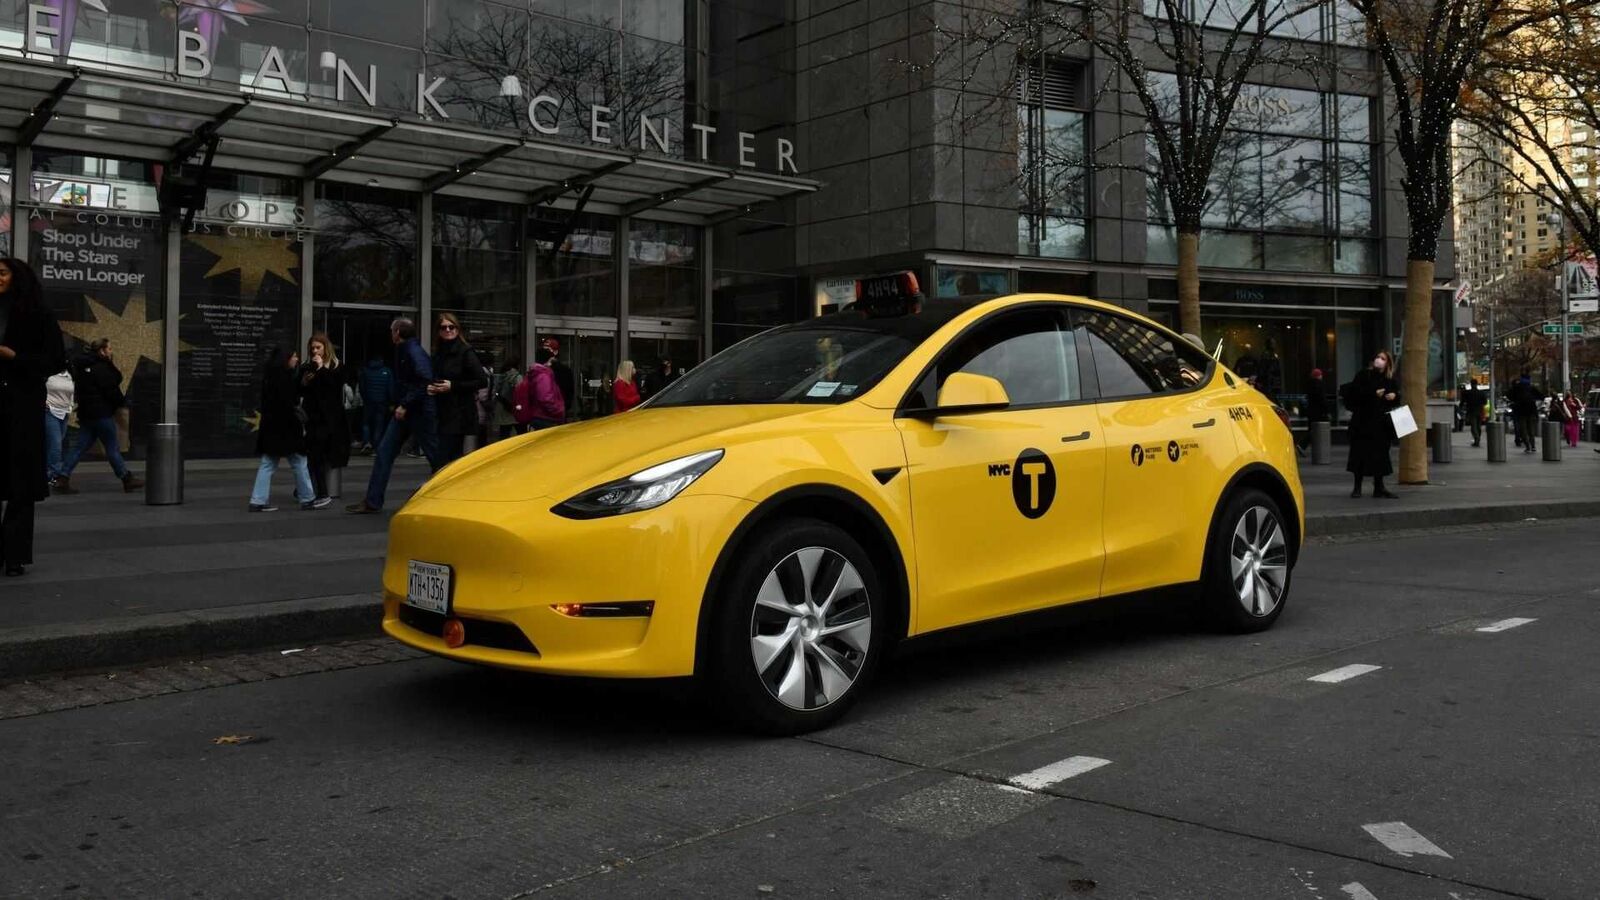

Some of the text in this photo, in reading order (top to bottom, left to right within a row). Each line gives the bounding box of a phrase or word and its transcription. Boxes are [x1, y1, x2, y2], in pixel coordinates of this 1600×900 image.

[177, 29, 448, 118] BANK
[528, 95, 799, 173] CENTER
[35, 180, 127, 209] THE
[30, 208, 58, 223] AT
[227, 225, 304, 242] CIRCLE
[43, 229, 140, 250] Shop Under
[43, 247, 119, 265] The Stars
[43, 266, 145, 285] Even Longer
[867, 279, 899, 298] 4H94
[1228, 406, 1253, 421] 4H94
[988, 463, 1011, 476] NYC
[1022, 462, 1046, 510] T
